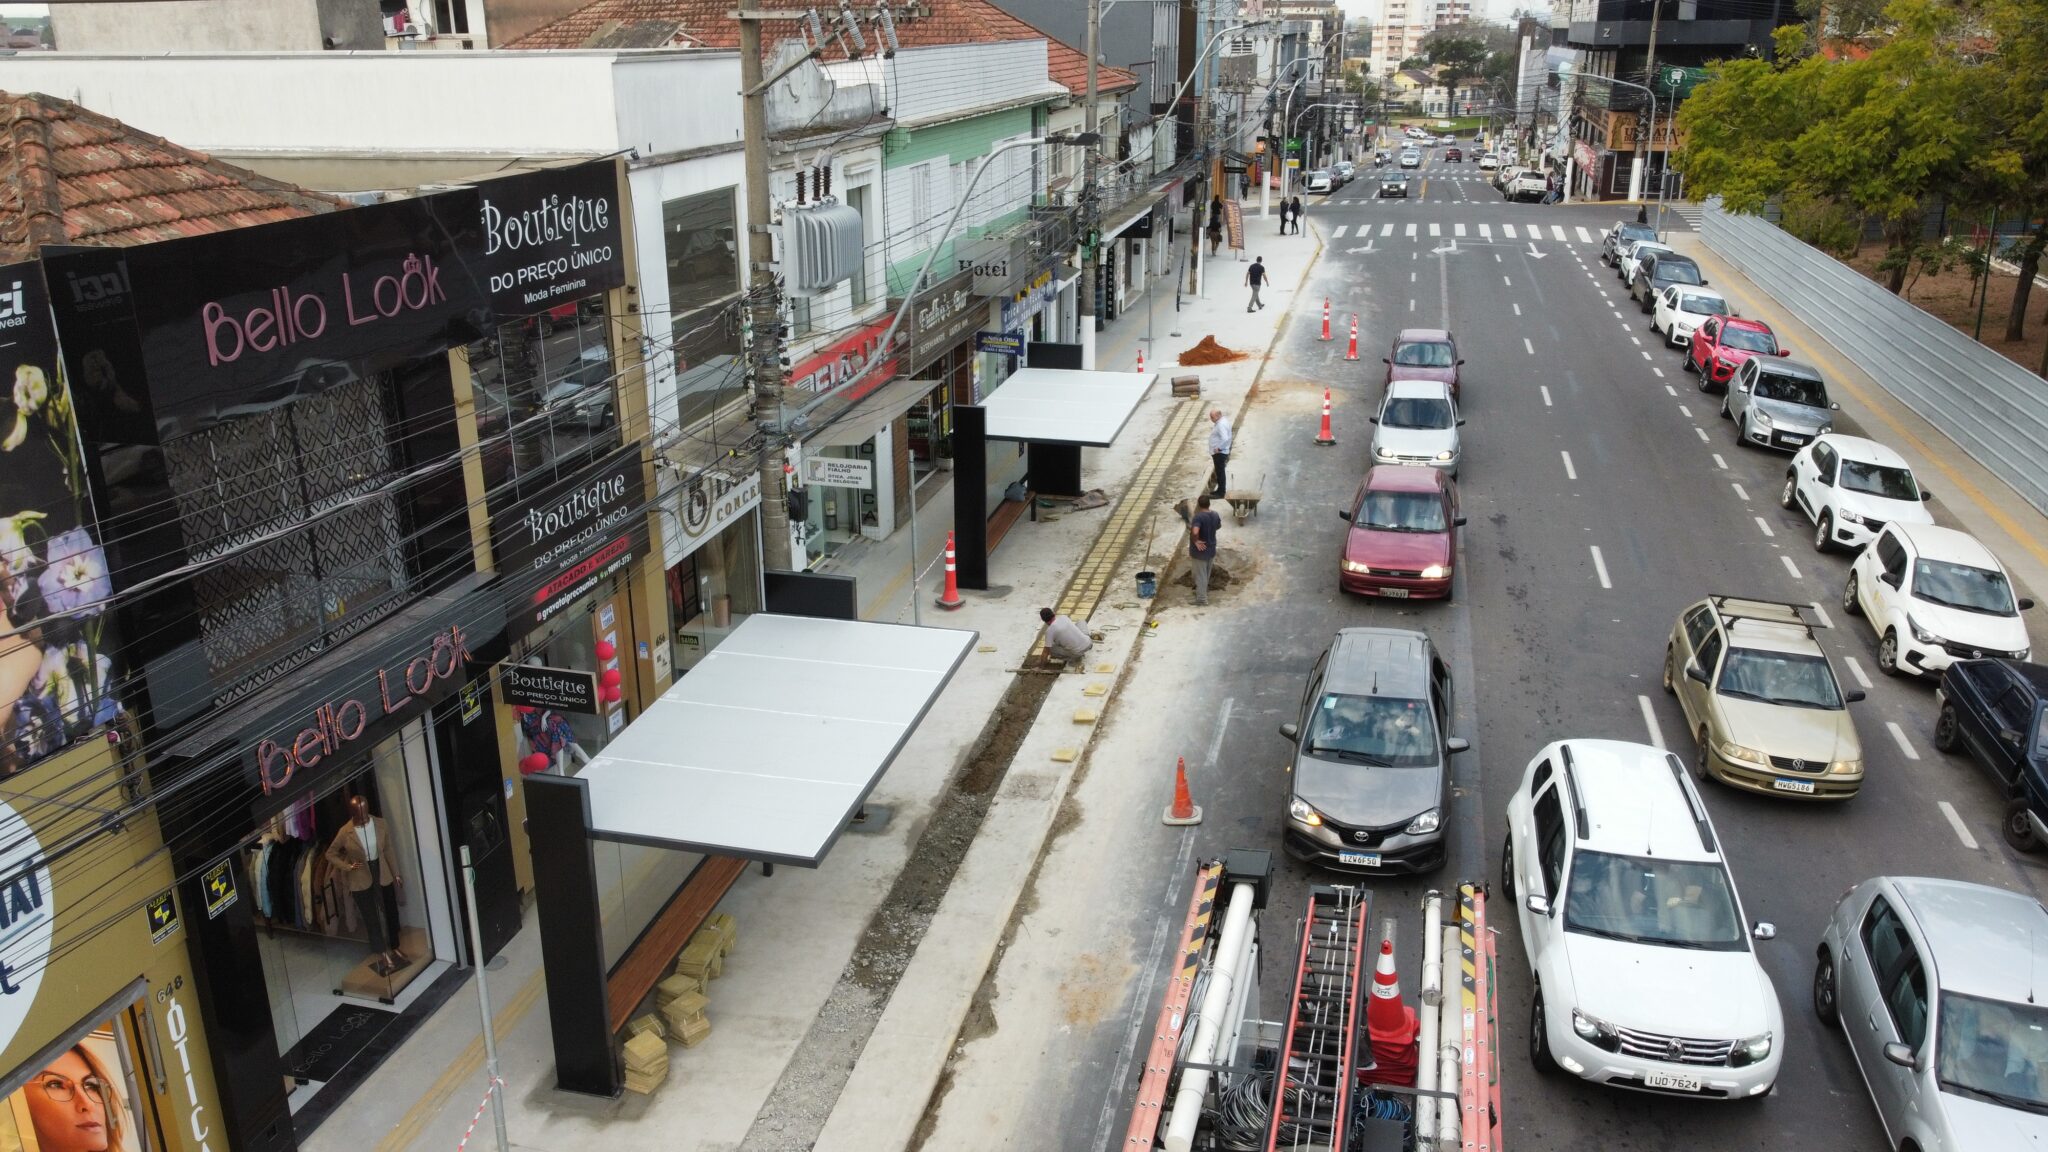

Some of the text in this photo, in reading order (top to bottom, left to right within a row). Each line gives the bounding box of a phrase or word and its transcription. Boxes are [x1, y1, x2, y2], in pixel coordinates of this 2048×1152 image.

[480, 194, 609, 255] Boutique
[490, 246, 612, 293] DO PREÇO ÚNICO
[524, 278, 586, 304] Moda Feminina
[202, 253, 446, 367] Bello Look
[524, 473, 625, 546] Boutique
[534, 551, 552, 569] DO
[555, 526, 593, 558] PREÇO
[508, 670, 586, 695] Boutique
[526, 691, 557, 700] PREÇO
[258, 699, 366, 796] Bello
[379, 624, 473, 714] Look
[156, 975, 183, 1004] 648
[1671, 1078, 1698, 1090] 7624
